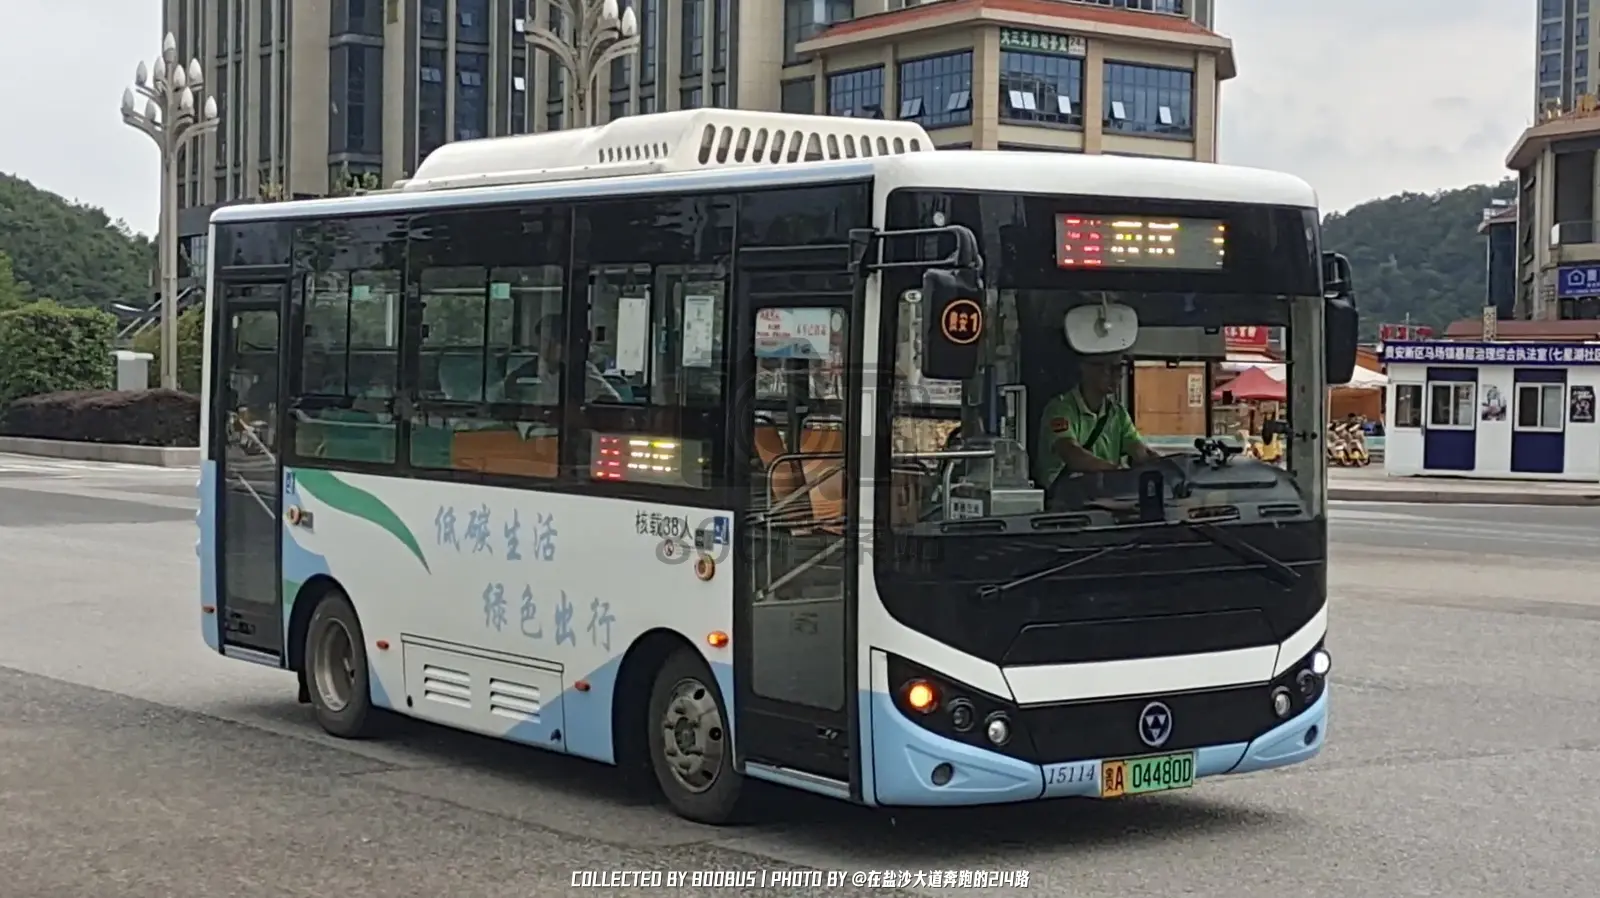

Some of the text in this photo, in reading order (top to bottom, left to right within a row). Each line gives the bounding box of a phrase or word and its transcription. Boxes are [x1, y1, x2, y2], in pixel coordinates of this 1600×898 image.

[434, 502, 558, 561] 低碳生活
[635, 510, 693, 540] 核载38人
[482, 582, 616, 653] 绿色出行
[1048, 764, 1095, 785] 15114
